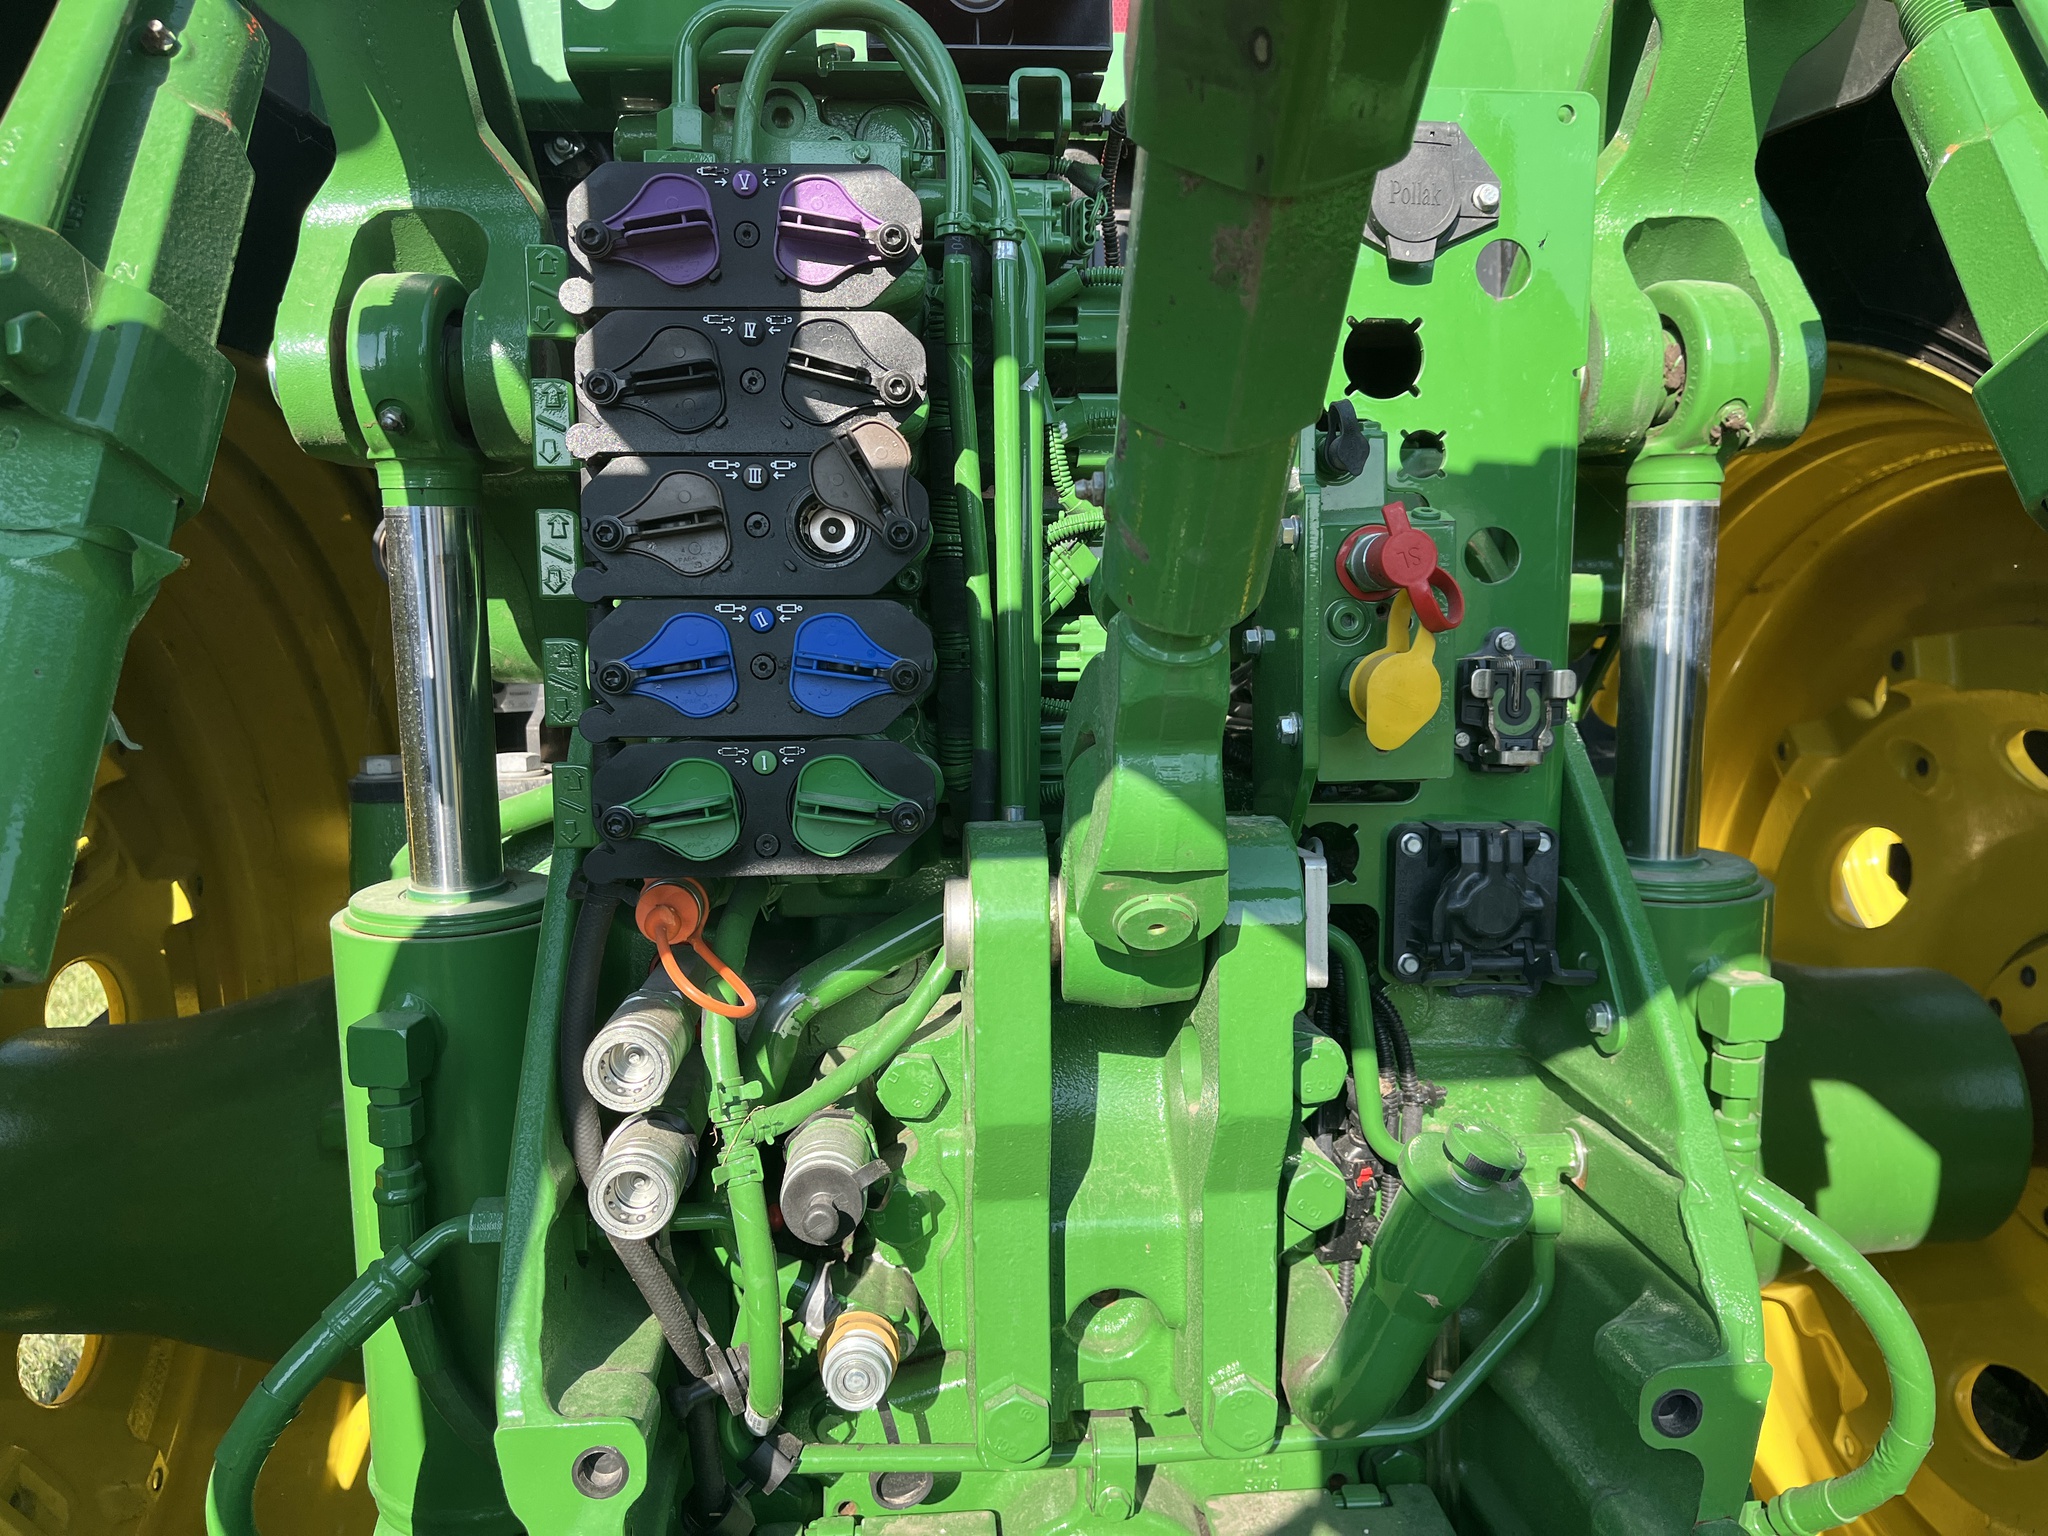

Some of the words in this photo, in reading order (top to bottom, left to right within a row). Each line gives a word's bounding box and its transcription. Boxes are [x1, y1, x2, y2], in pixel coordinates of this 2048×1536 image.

[738, 174, 751, 191] V
[1389, 179, 1441, 207] Pollak
[743, 323, 757, 339] IV
[748, 468, 762, 484] III
[752, 612, 769, 628] II
[760, 756, 768, 771] I
